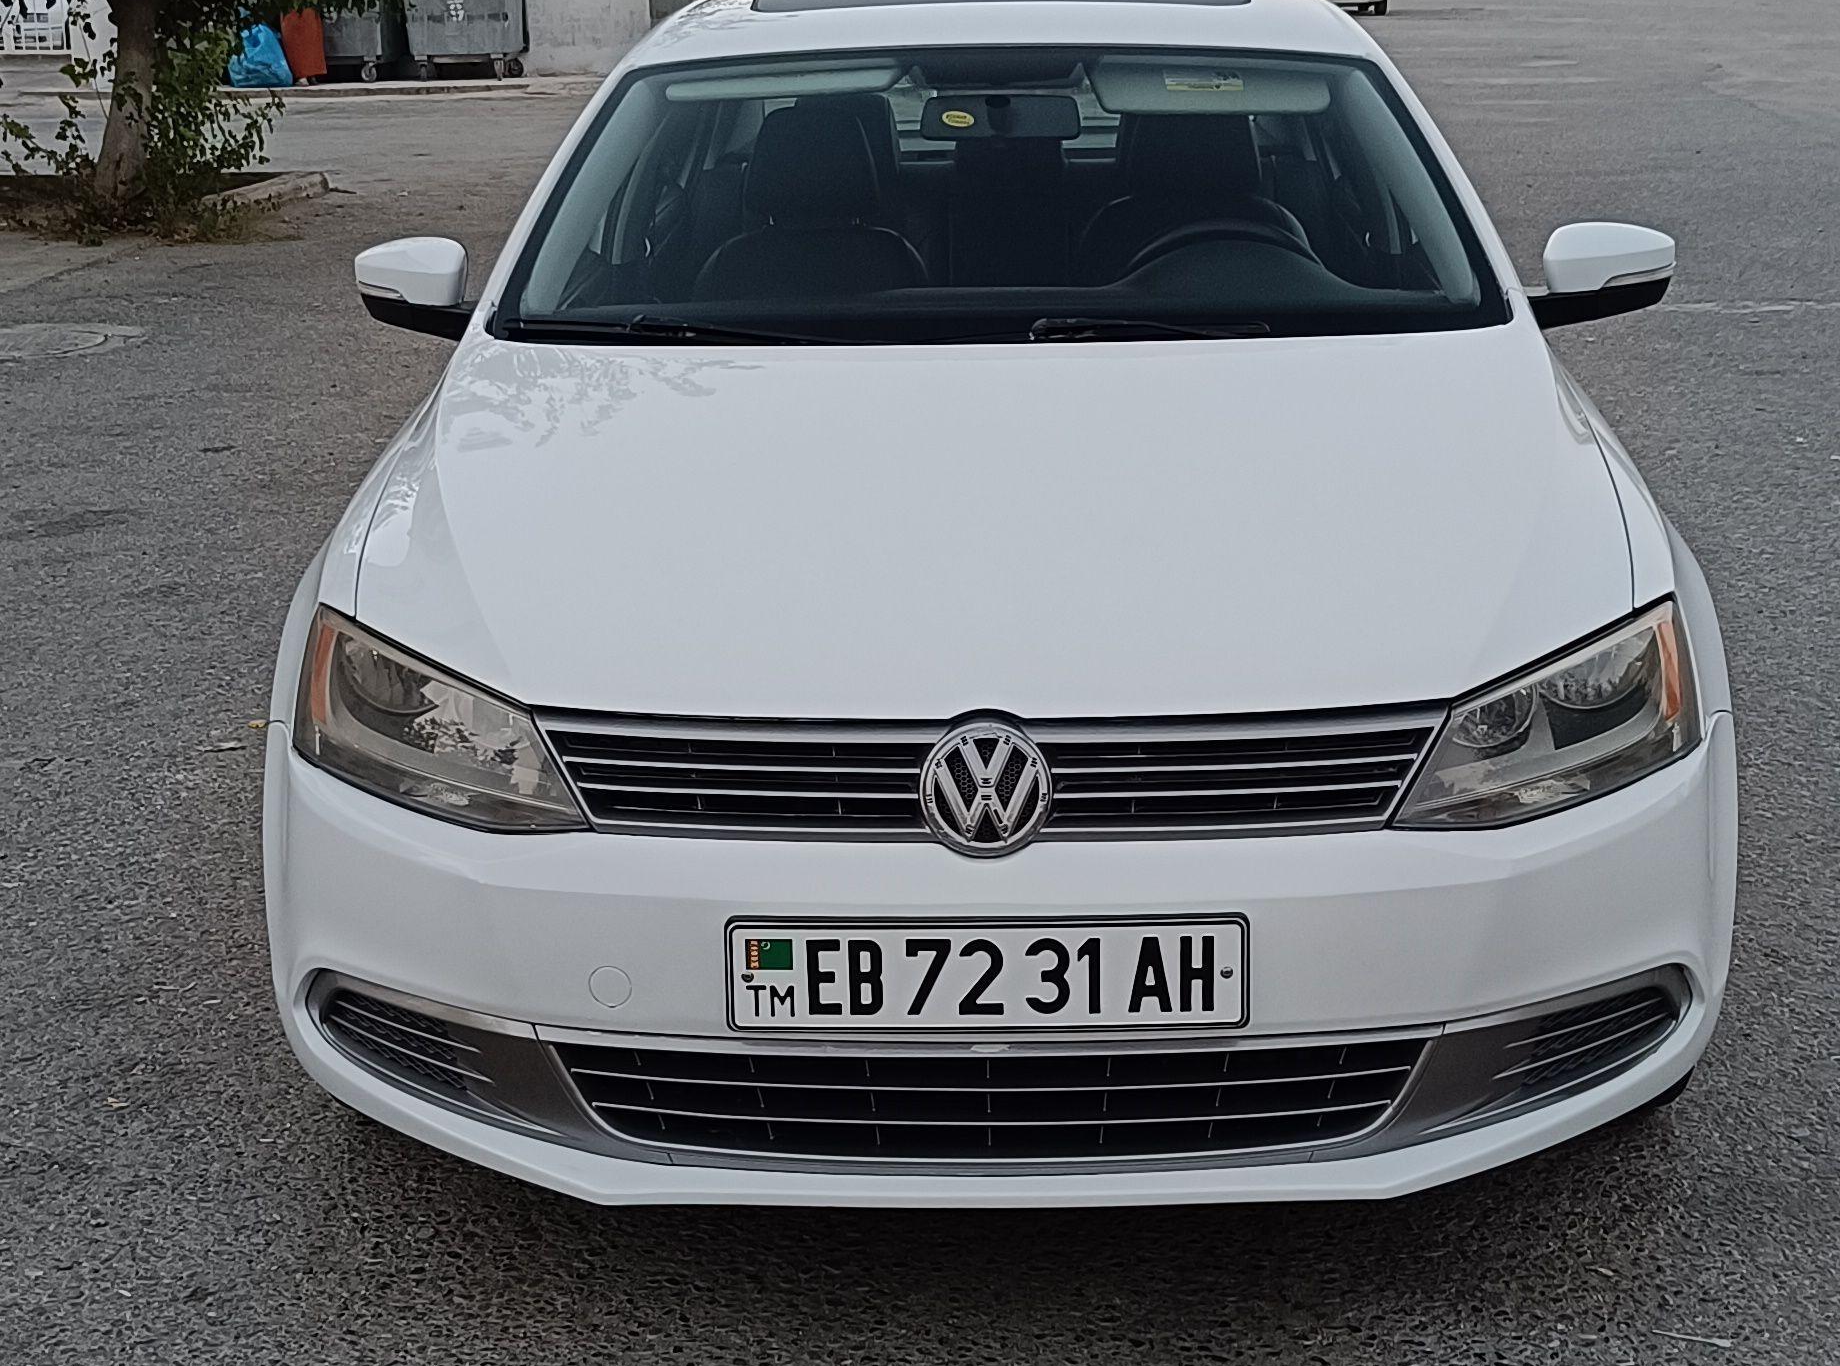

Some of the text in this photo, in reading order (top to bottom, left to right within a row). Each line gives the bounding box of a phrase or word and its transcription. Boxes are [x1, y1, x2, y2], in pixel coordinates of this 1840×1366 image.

[930, 731, 1041, 843] VW
[745, 984, 796, 1017] TM
[805, 935, 1215, 1015] EB 72 31 AH
